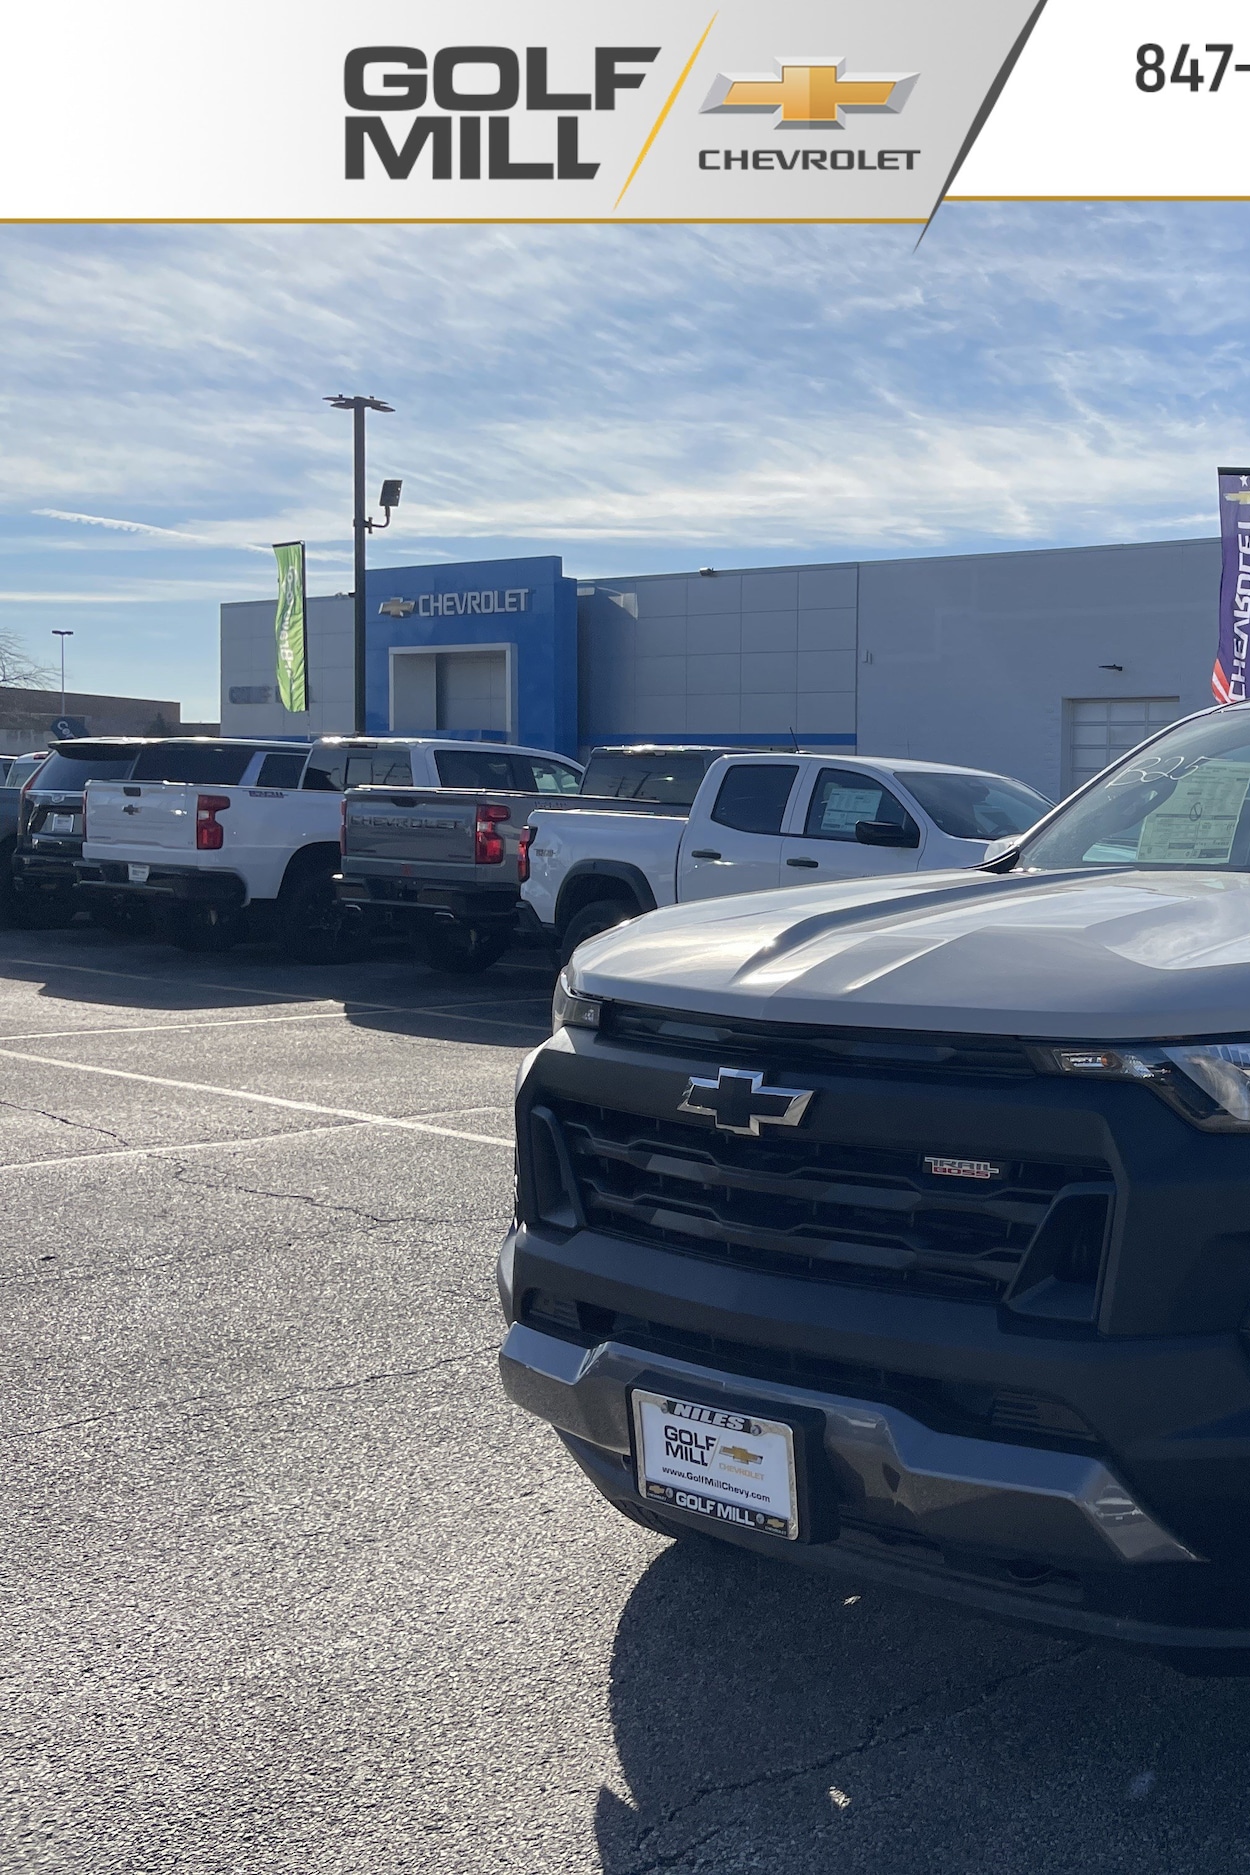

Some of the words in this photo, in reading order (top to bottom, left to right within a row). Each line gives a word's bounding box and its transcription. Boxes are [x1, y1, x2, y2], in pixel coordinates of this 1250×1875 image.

[418, 588, 529, 617] CHEVROLET
[1105, 755, 1233, 789] B25
[924, 1156, 999, 1174] TRAIL
[932, 1166, 991, 1179] BOSS
[674, 1403, 745, 1431] NILES
[664, 1425, 717, 1451] GOLF
[665, 1440, 708, 1467] MILL
[662, 1466, 771, 1503] www.GolfMillChevy.com
[718, 1462, 765, 1481] CHEVROLET
[676, 1491, 715, 1514] GOLF
[717, 1502, 755, 1526] MILL
